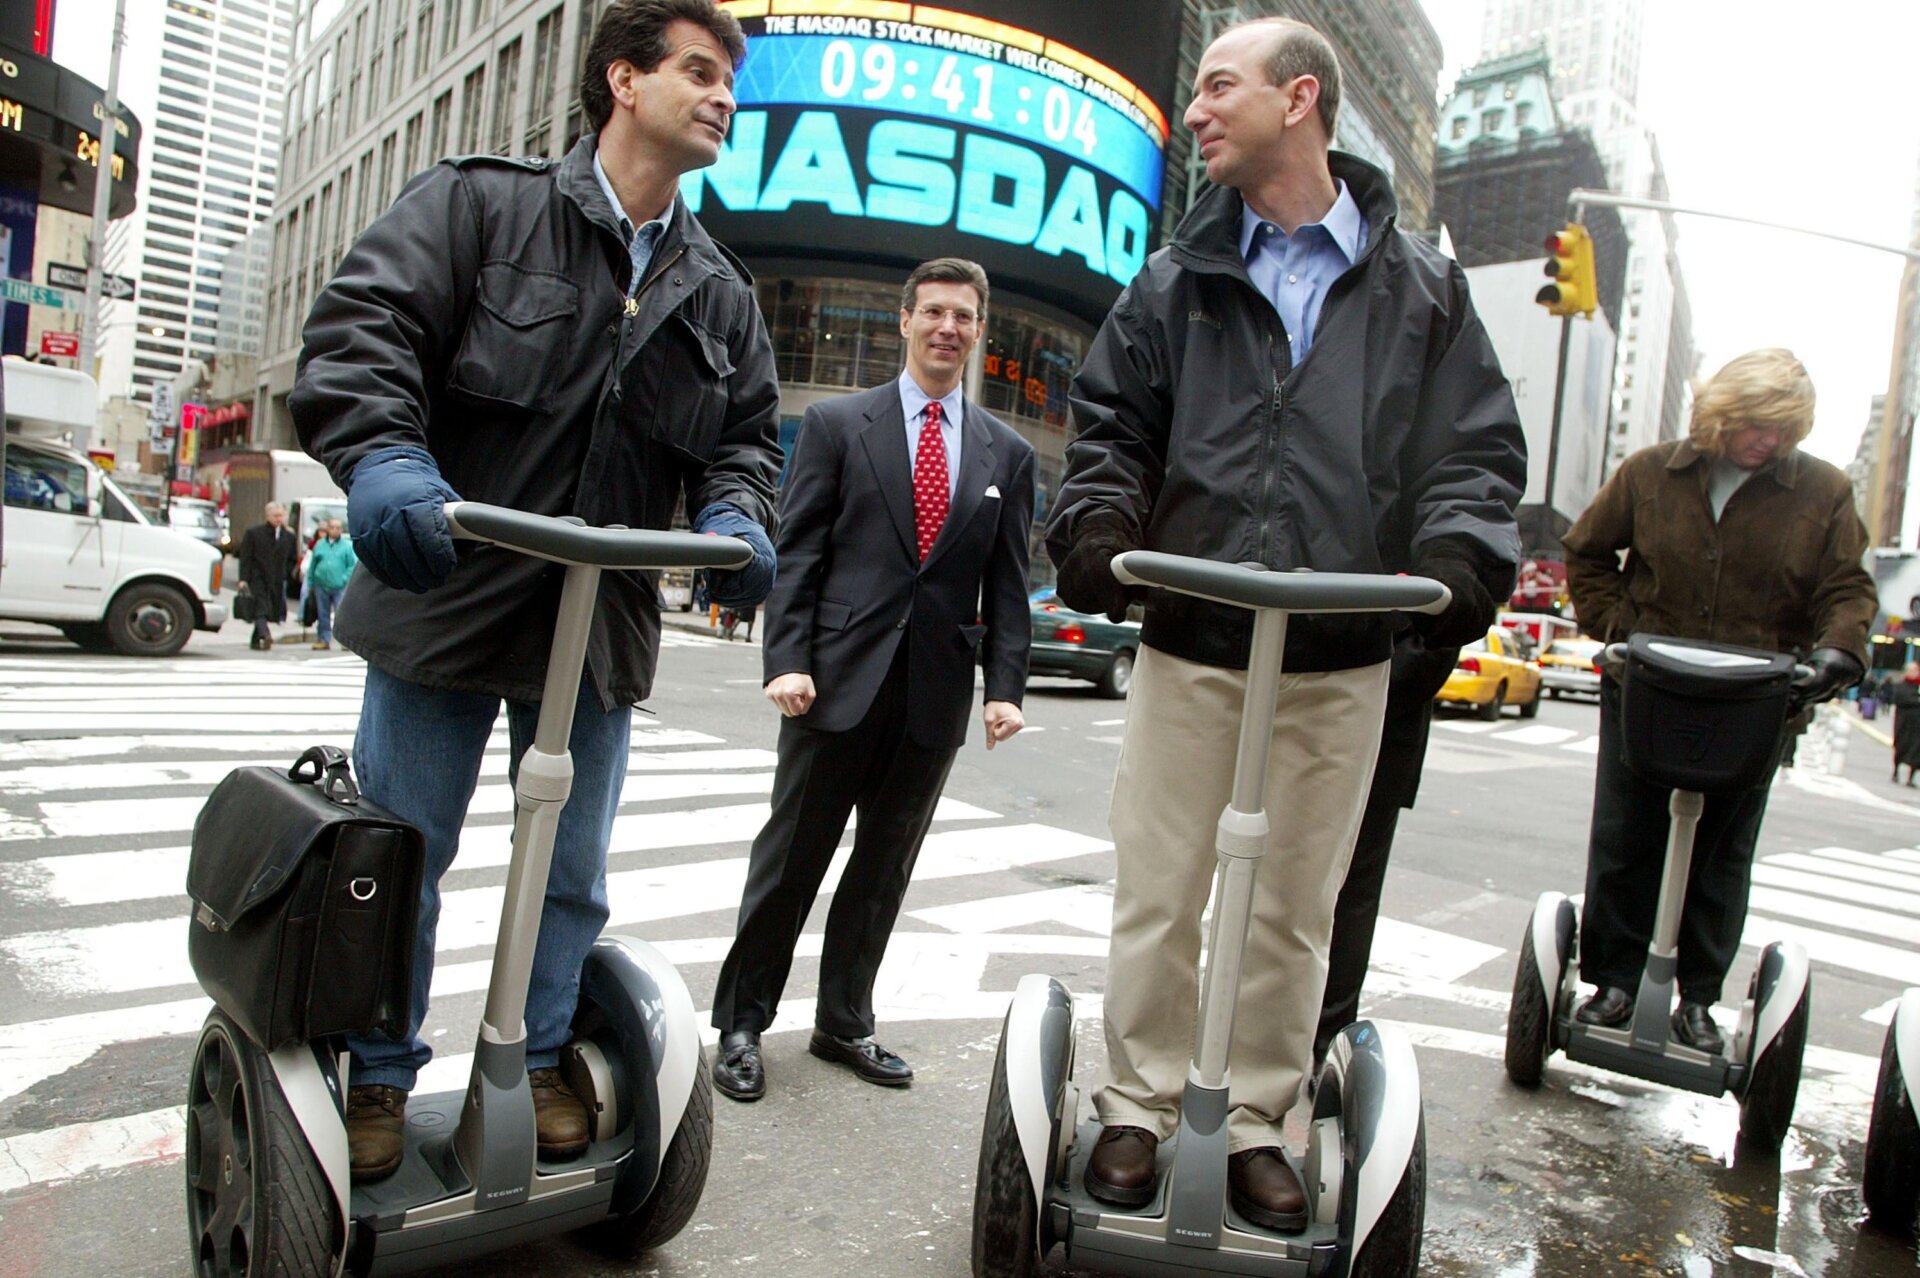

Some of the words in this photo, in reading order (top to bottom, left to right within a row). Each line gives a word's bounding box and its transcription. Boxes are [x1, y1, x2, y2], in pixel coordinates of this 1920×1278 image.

[764, 16, 795, 34] THE
[796, 16, 872, 38] NASDAQ
[875, 20, 934, 44] STOCK
[934, 28, 1004, 60] MARKET
[1006, 45, 1084, 91] WELCOMES
[0, 58, 18, 78] O
[679, 110, 1148, 288] NASDAQ
[59, 270, 83, 284] ONE
[6, 281, 47, 303] TIMES
[487, 1187, 525, 1199] SEGWAY
[1175, 1228, 1213, 1238] SEGWAY
